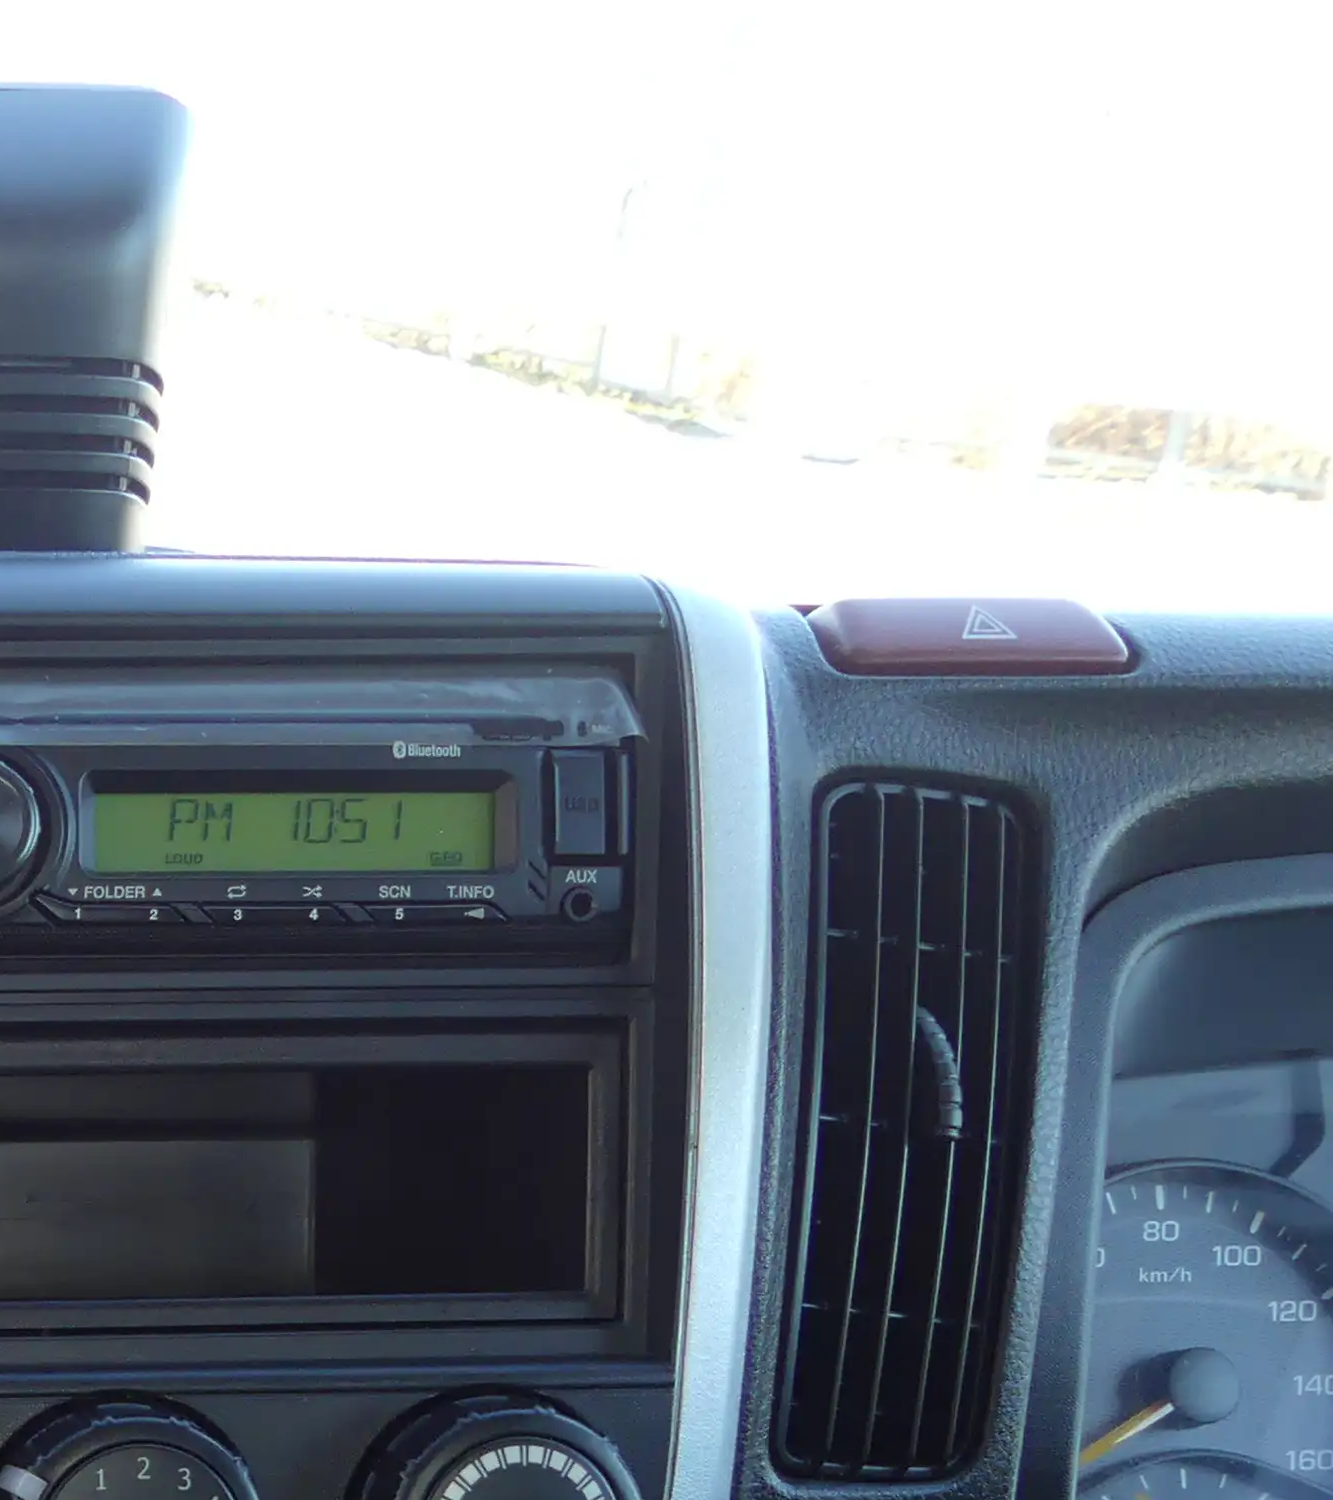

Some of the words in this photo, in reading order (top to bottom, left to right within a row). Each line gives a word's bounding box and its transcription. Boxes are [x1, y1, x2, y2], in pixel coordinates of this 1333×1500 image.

[407, 743, 461, 757] Bluetooth
[167, 799, 233, 843] PM
[165, 852, 204, 865] LOUD
[565, 869, 598, 884] AUX
[84, 886, 145, 899] FOLDER
[378, 885, 412, 899] SCN
[447, 885, 495, 899] T.INFO
[74, 908, 81, 919] 1
[149, 908, 159, 920] 2
[233, 908, 243, 920] 3
[309, 908, 319, 920] 4
[395, 908, 404, 920] 5
[1142, 1220, 1180, 1242] 80
[1211, 1245, 1262, 1267] 100
[1139, 1267, 1193, 1283] km/h
[1268, 1300, 1318, 1322] 120
[1285, 1449, 1333, 1471] 160
[137, 1456, 151, 1480] 2
[96, 1468, 107, 1491] 1
[177, 1468, 191, 1491] 3
